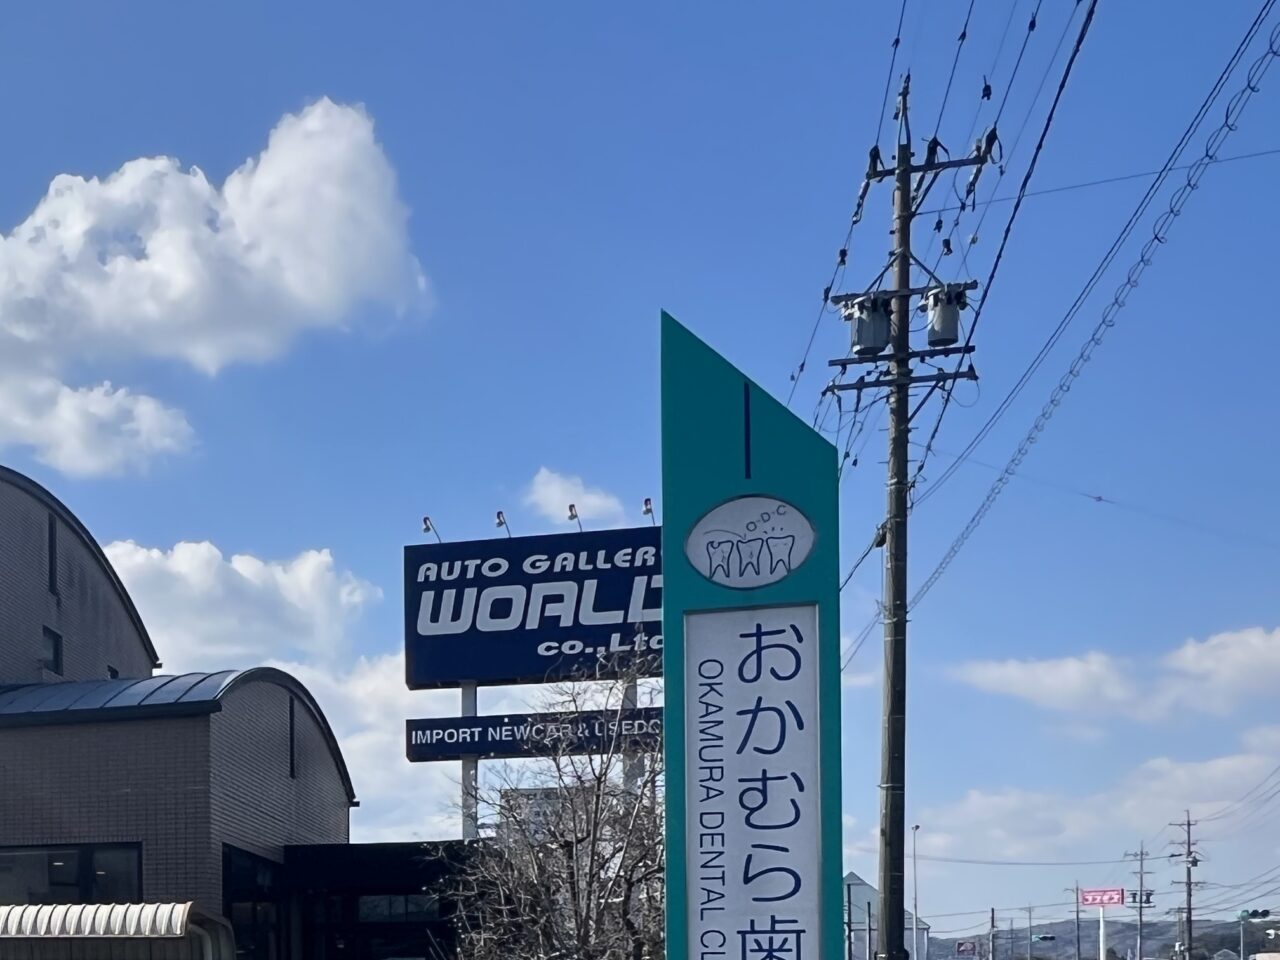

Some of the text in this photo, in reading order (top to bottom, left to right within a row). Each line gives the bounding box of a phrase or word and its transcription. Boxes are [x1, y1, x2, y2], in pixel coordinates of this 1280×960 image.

[417, 546, 663, 582] AUTO GALLER
[411, 728, 482, 745] IMPORT
[698, 658, 725, 802] OKAMURA
[699, 811, 725, 922] DENTAL
